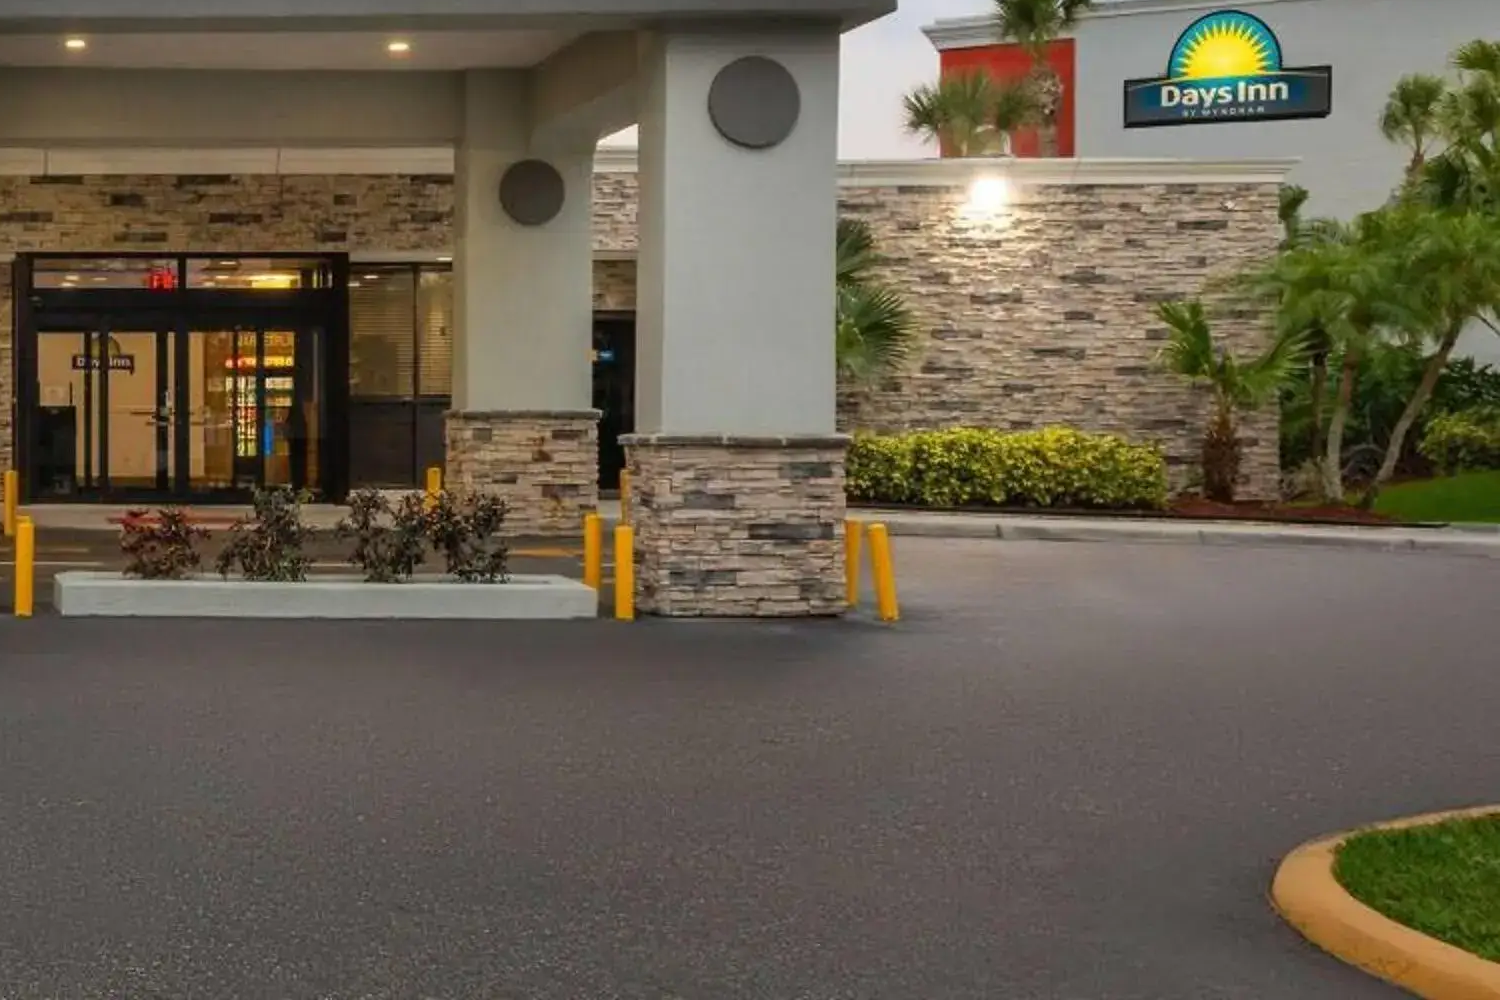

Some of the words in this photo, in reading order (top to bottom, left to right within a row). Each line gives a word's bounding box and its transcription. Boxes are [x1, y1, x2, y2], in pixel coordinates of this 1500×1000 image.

[1160, 85, 1233, 107] Days
[1237, 81, 1289, 102] Inn
[1181, 109, 1197, 117] BY
[1201, 106, 1266, 116] WYNDHAM
